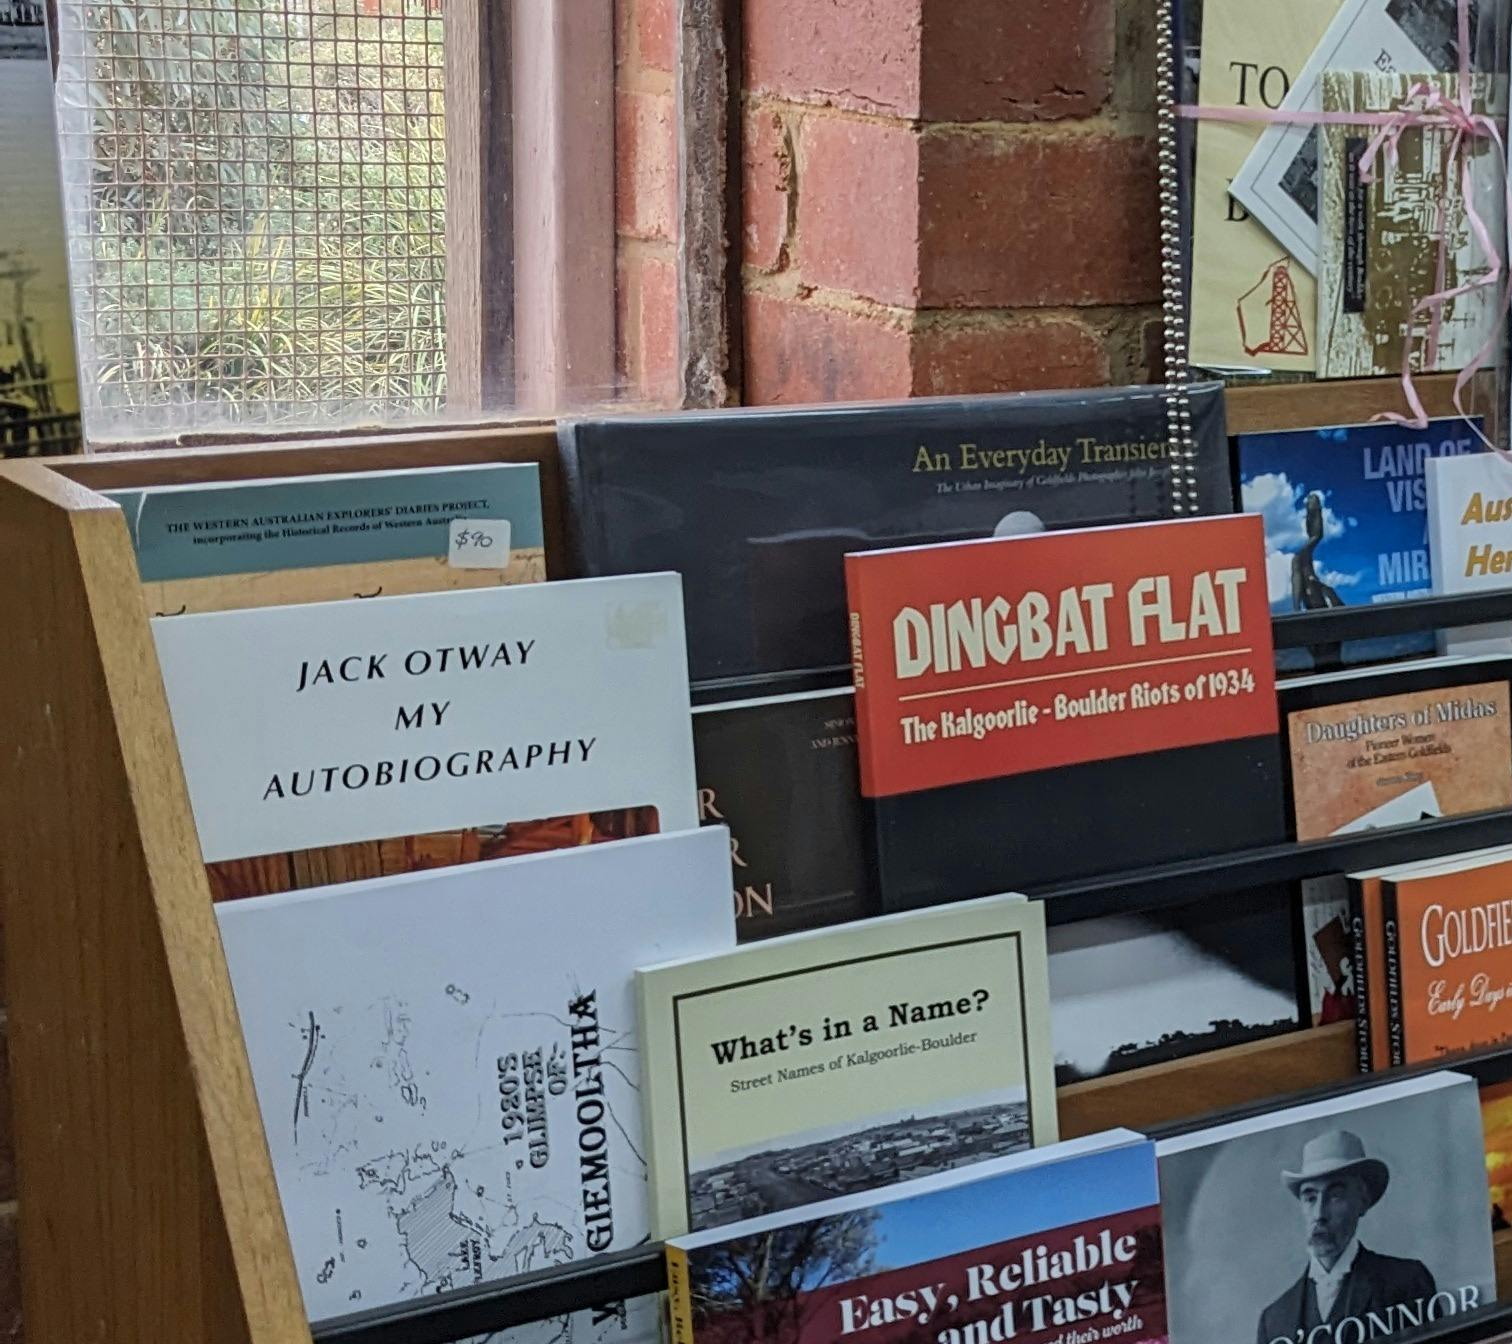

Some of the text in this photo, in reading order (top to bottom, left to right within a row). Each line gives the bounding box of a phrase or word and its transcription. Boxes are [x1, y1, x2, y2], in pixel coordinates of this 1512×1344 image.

[167, 522, 189, 534] THE
[194, 518, 249, 532] WESTERN
[252, 513, 324, 528] AUSTRALIAN
[396, 504, 440, 516] DIARIES
[264, 529, 280, 539] the
[282, 525, 330, 539] Historical
[333, 522, 369, 534] Records
[372, 521, 383, 531] of
[385, 517, 422, 528] Western
[892, 568, 1248, 681] DINGBAT FLAT
[296, 638, 537, 693] JACK OTWAY
[393, 701, 452, 731] MY
[900, 672, 1254, 745] The Kalgoorlie Boulder Riots of 1934
[1306, 697, 1497, 745] Daughters of Midas
[262, 737, 598, 801] AUTOBIOGRAPHY
[1358, 755, 1372, 767] the
[1366, 733, 1436, 752] Pioneer Women
[712, 987, 991, 1067] What's in a Name?
[729, 1029, 978, 1094] Street Names of Kalgoorlie-Boulder
[839, 1228, 1137, 1337] Easy, Reliable
[1021, 1277, 1140, 1335] Tasty
